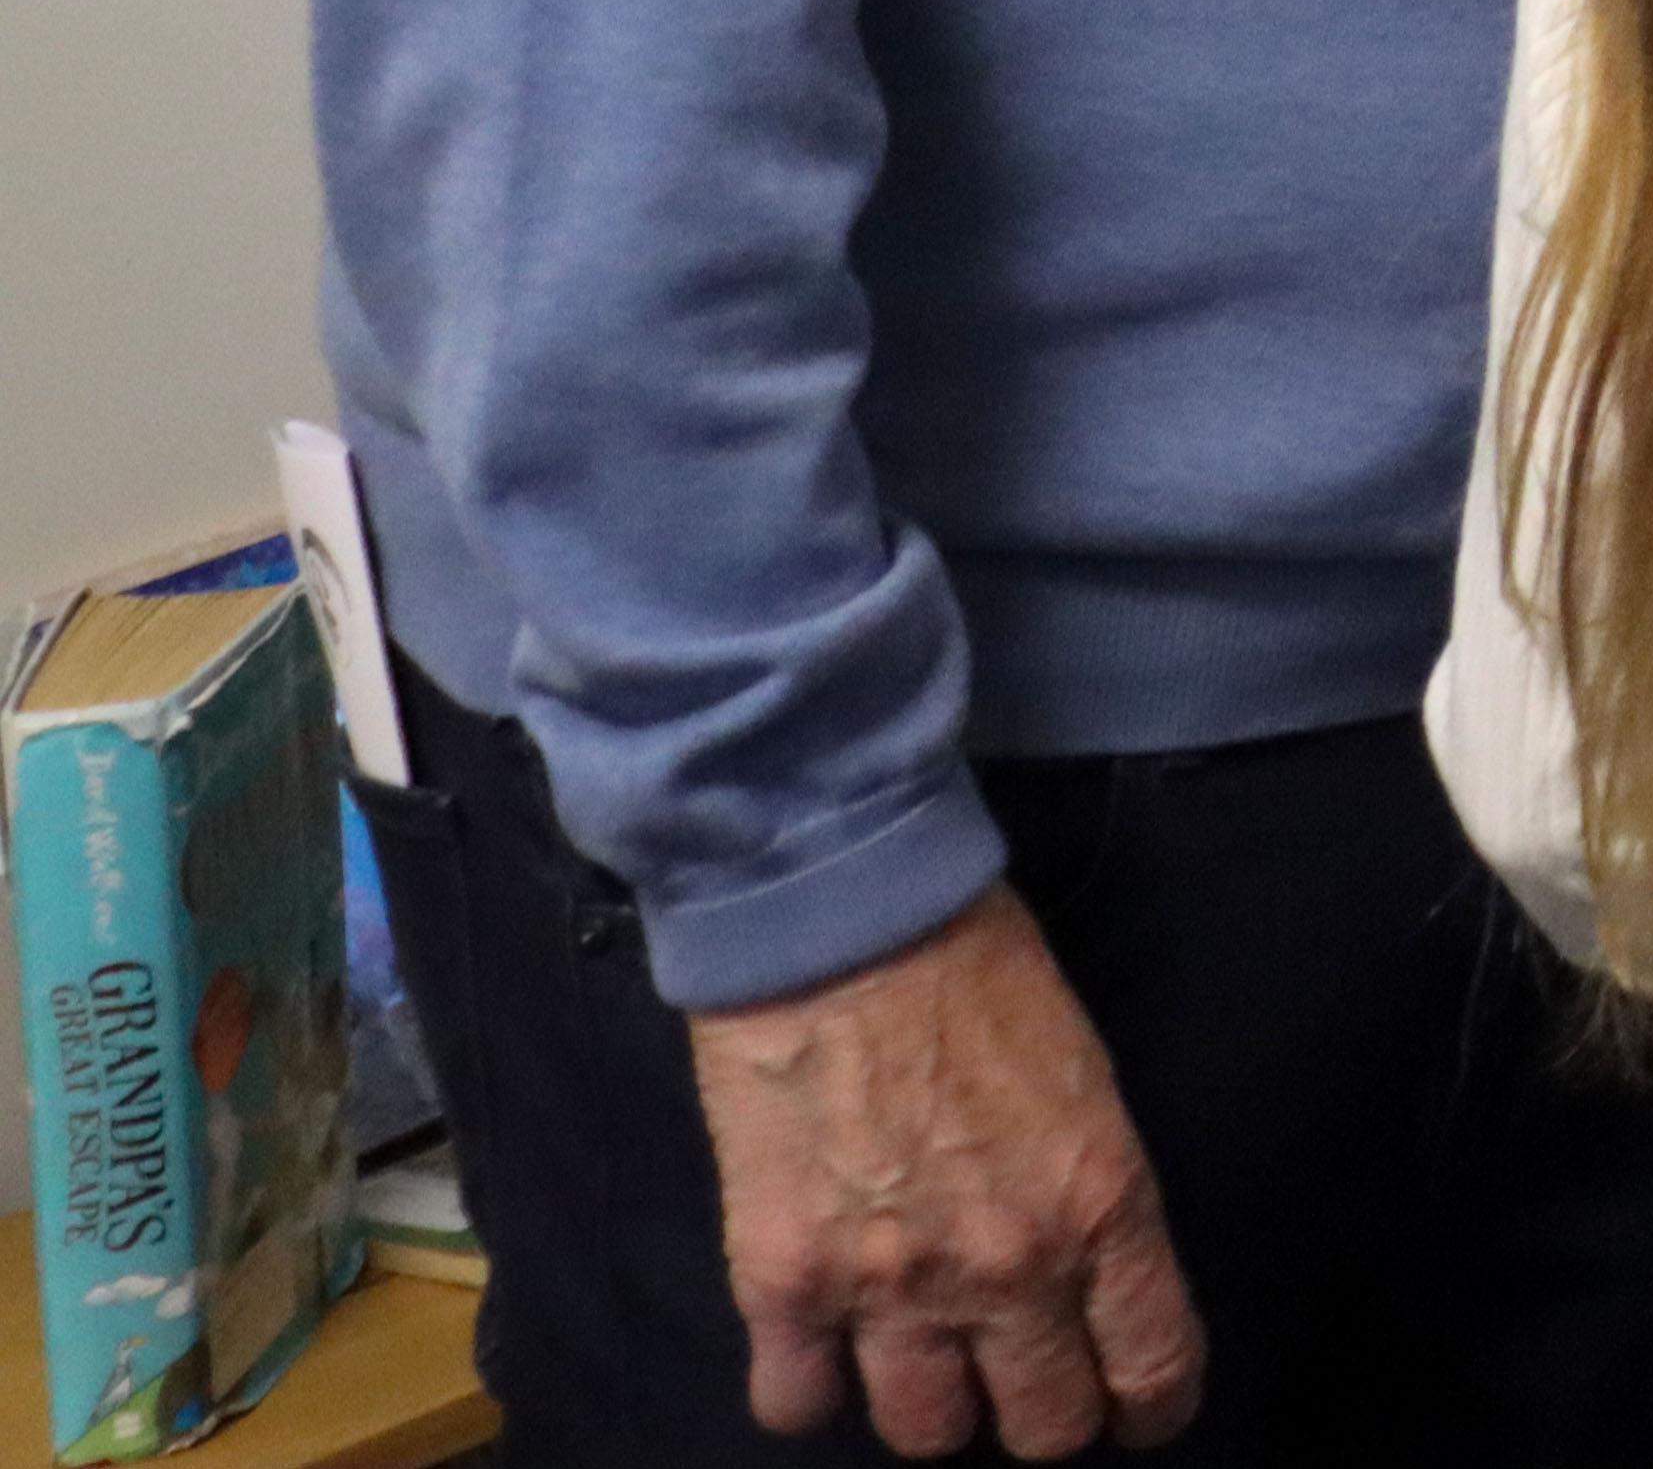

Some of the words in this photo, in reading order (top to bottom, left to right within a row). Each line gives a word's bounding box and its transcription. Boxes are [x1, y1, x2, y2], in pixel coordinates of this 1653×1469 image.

[50, 984, 99, 1095] GREAT
[87, 961, 176, 1252] GRANDPA'S
[63, 1110, 100, 1249] ESCAPE
